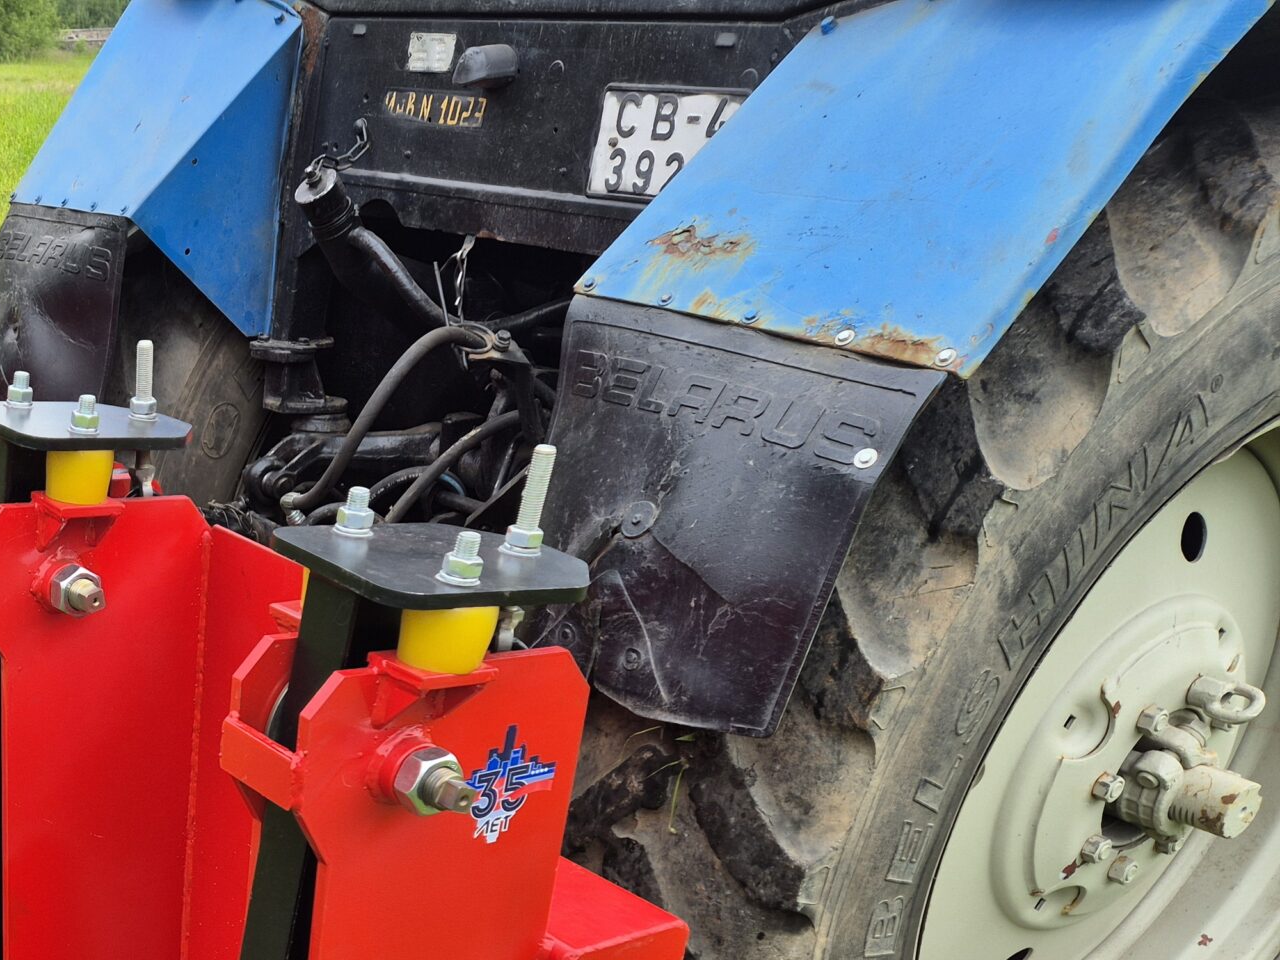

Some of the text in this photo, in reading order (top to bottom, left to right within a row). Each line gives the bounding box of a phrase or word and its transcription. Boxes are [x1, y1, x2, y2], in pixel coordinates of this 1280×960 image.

[438, 95, 487, 127] 1023
[571, 349, 881, 465] BELARUS
[471, 763, 531, 819] 35
[475, 814, 512, 836] ЛЕТ
